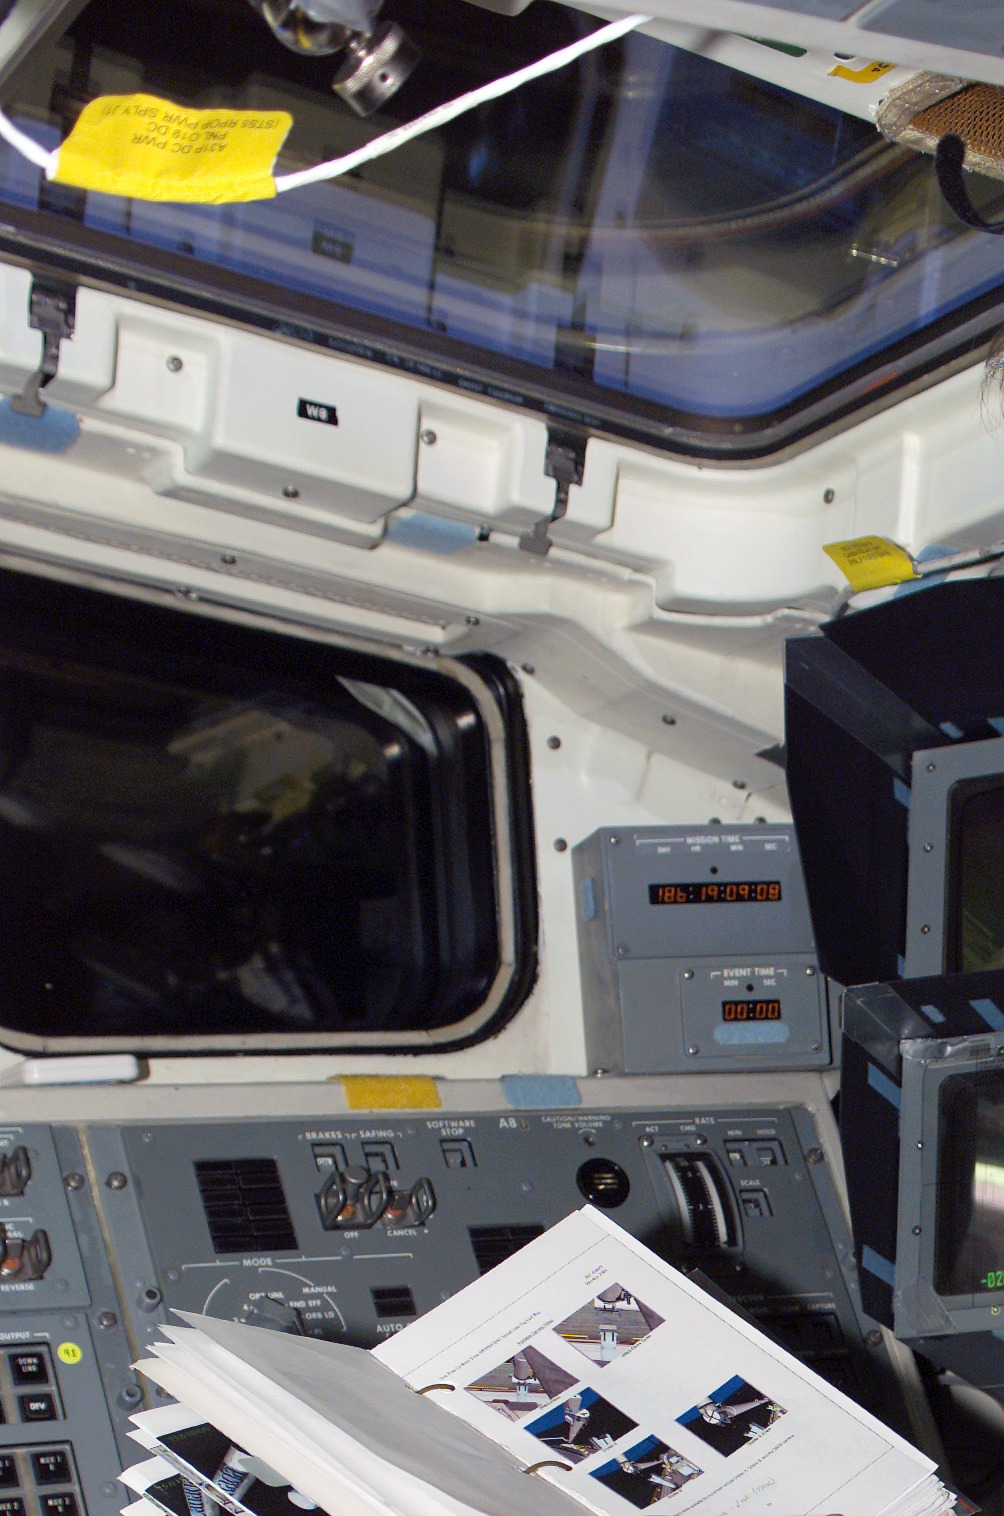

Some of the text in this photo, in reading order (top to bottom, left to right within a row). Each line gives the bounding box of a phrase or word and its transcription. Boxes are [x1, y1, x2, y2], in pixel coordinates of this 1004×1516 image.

[723, 967, 775, 977] EVENT TIME
[724, 1002, 779, 1020] 00:00
[426, 1120, 475, 1129] SOFTWARE
[694, 1117, 715, 1125] RATE
[305, 1130, 342, 1140] BRAKES
[359, 1129, 394, 1139] SAFING
[441, 1128, 465, 1136] STOP
[387, 1229, 417, 1237] CANCEL
[242, 1258, 273, 1267] MODE
[302, 1285, 337, 1294] MANUAL
[376, 1323, 403, 1334] AUTO
